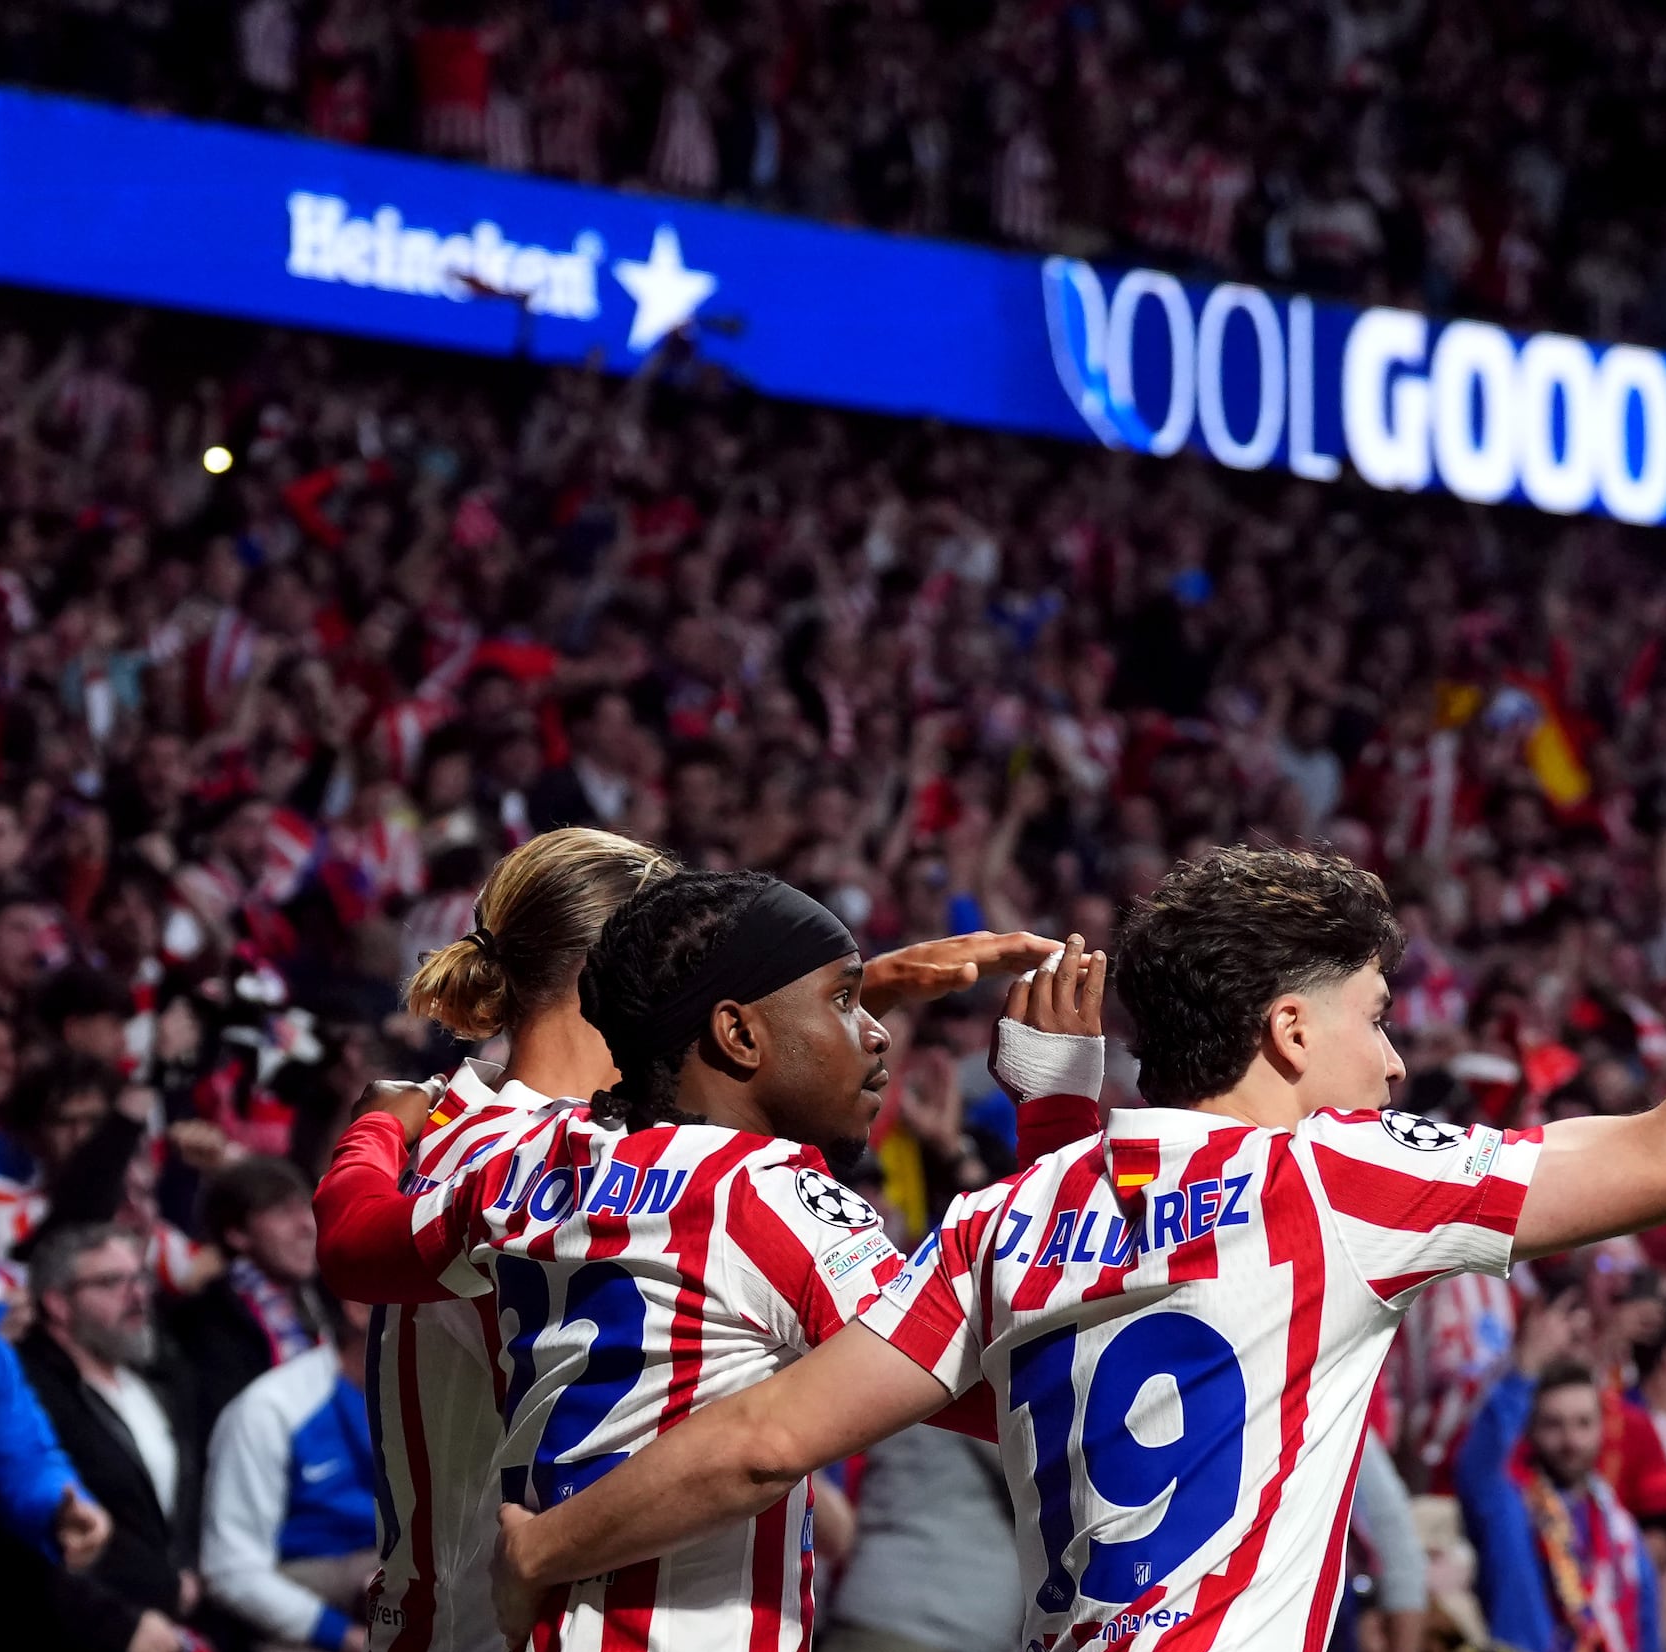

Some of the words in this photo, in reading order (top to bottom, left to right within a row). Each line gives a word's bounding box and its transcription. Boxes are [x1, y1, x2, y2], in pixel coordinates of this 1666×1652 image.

[286, 191, 600, 322] Heineken
[1475, 1132, 1498, 1178] FOUNDAT
[823, 1250, 841, 1266] UEFA
[994, 1209, 1033, 1264] J.
[1035, 1172, 1254, 1268] ALVAREZ
[1009, 1312, 1247, 1614] 19
